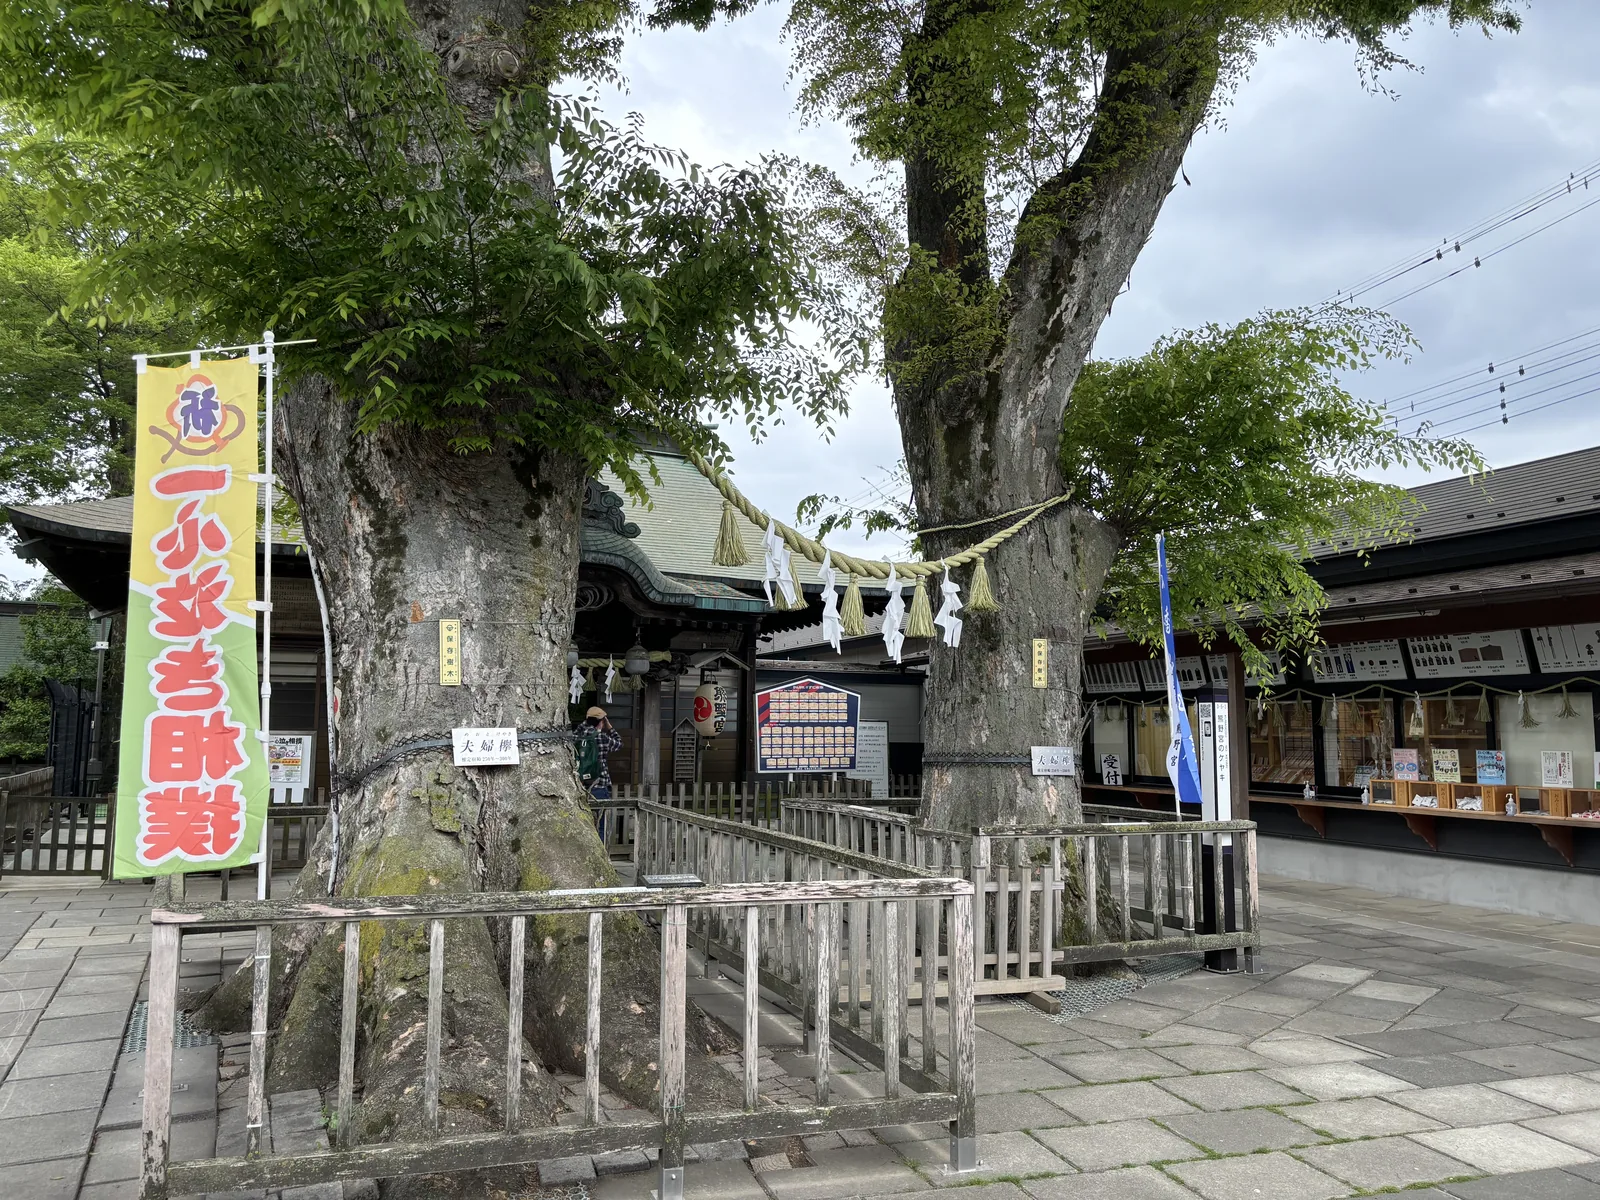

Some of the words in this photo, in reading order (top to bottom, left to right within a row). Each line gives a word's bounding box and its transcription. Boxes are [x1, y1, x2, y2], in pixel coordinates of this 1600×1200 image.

[446, 635, 454, 677] 保存樹木
[459, 739, 513, 754] 夫婦欅
[1217, 714, 1225, 781] 熊野宮のケヤキ
[1103, 754, 1121, 785] 受付
